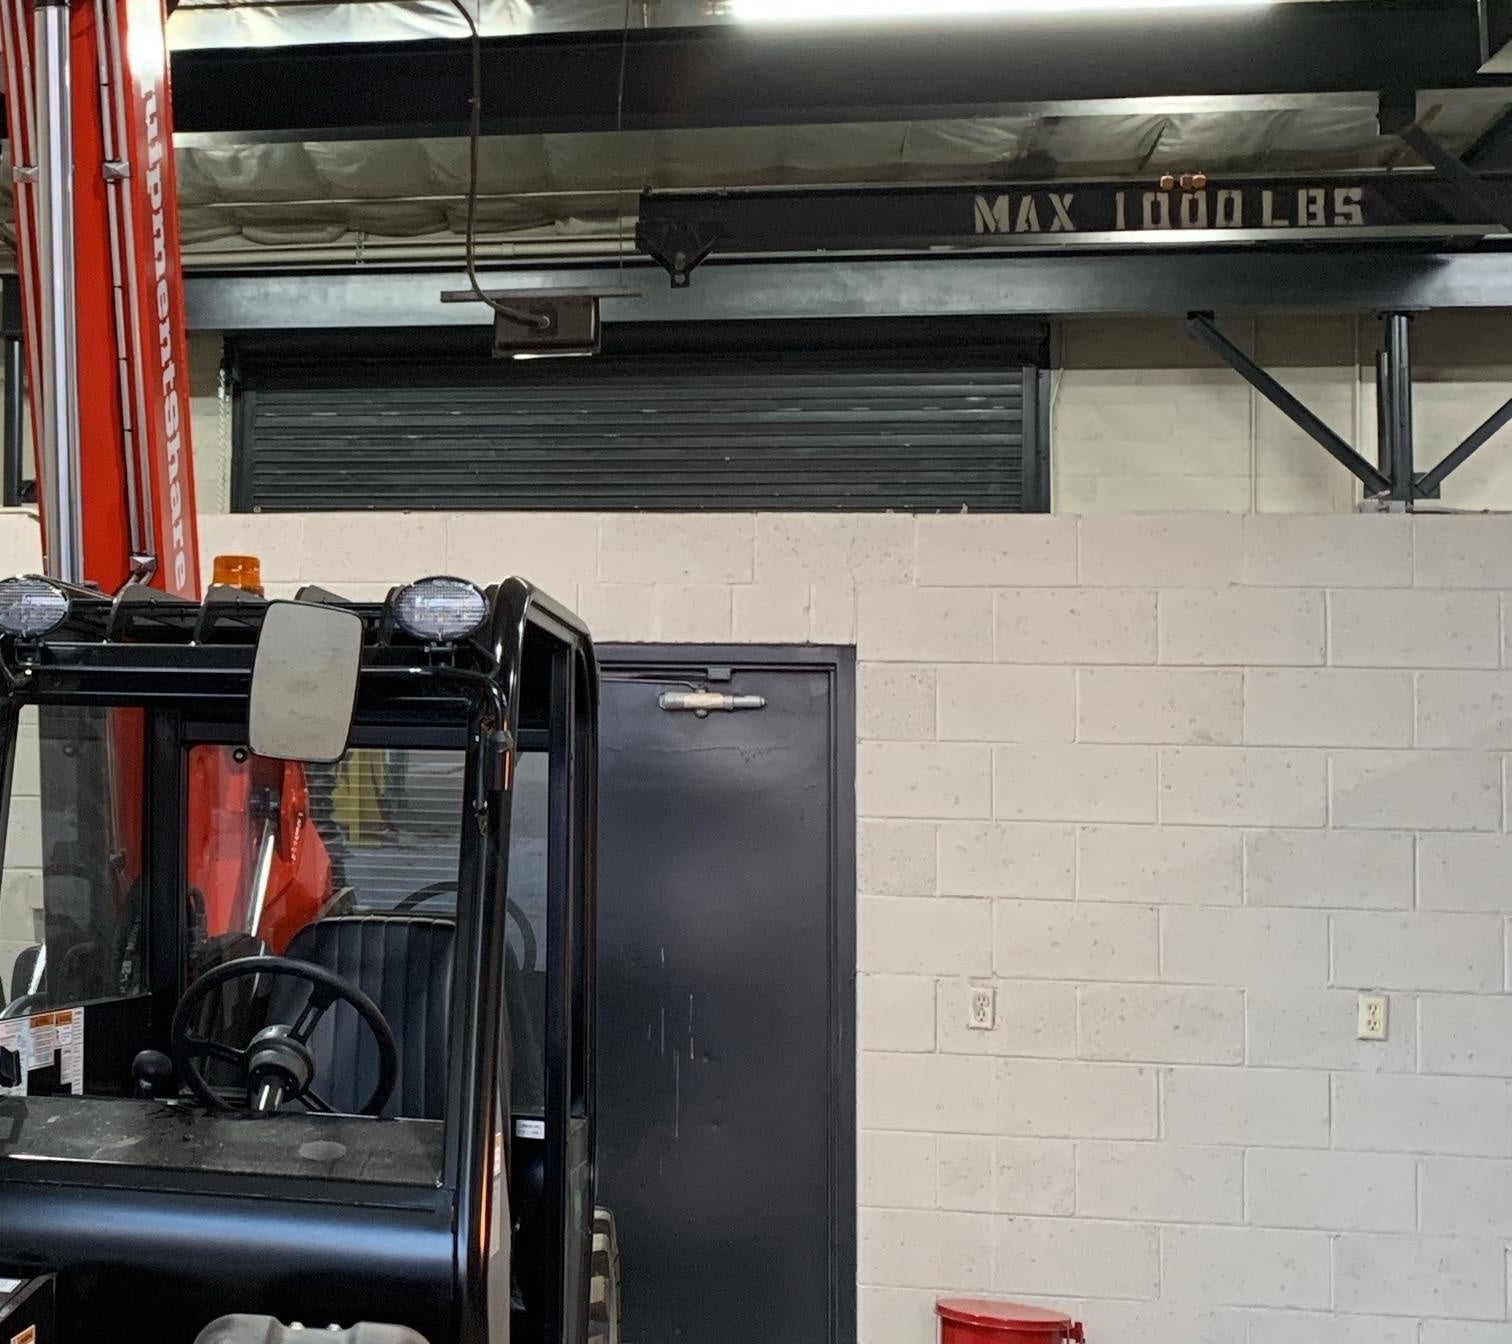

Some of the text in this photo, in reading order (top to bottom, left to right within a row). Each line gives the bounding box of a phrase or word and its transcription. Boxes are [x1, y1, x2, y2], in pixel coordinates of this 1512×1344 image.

[974, 188, 1365, 234] MAX 1000 LBS
